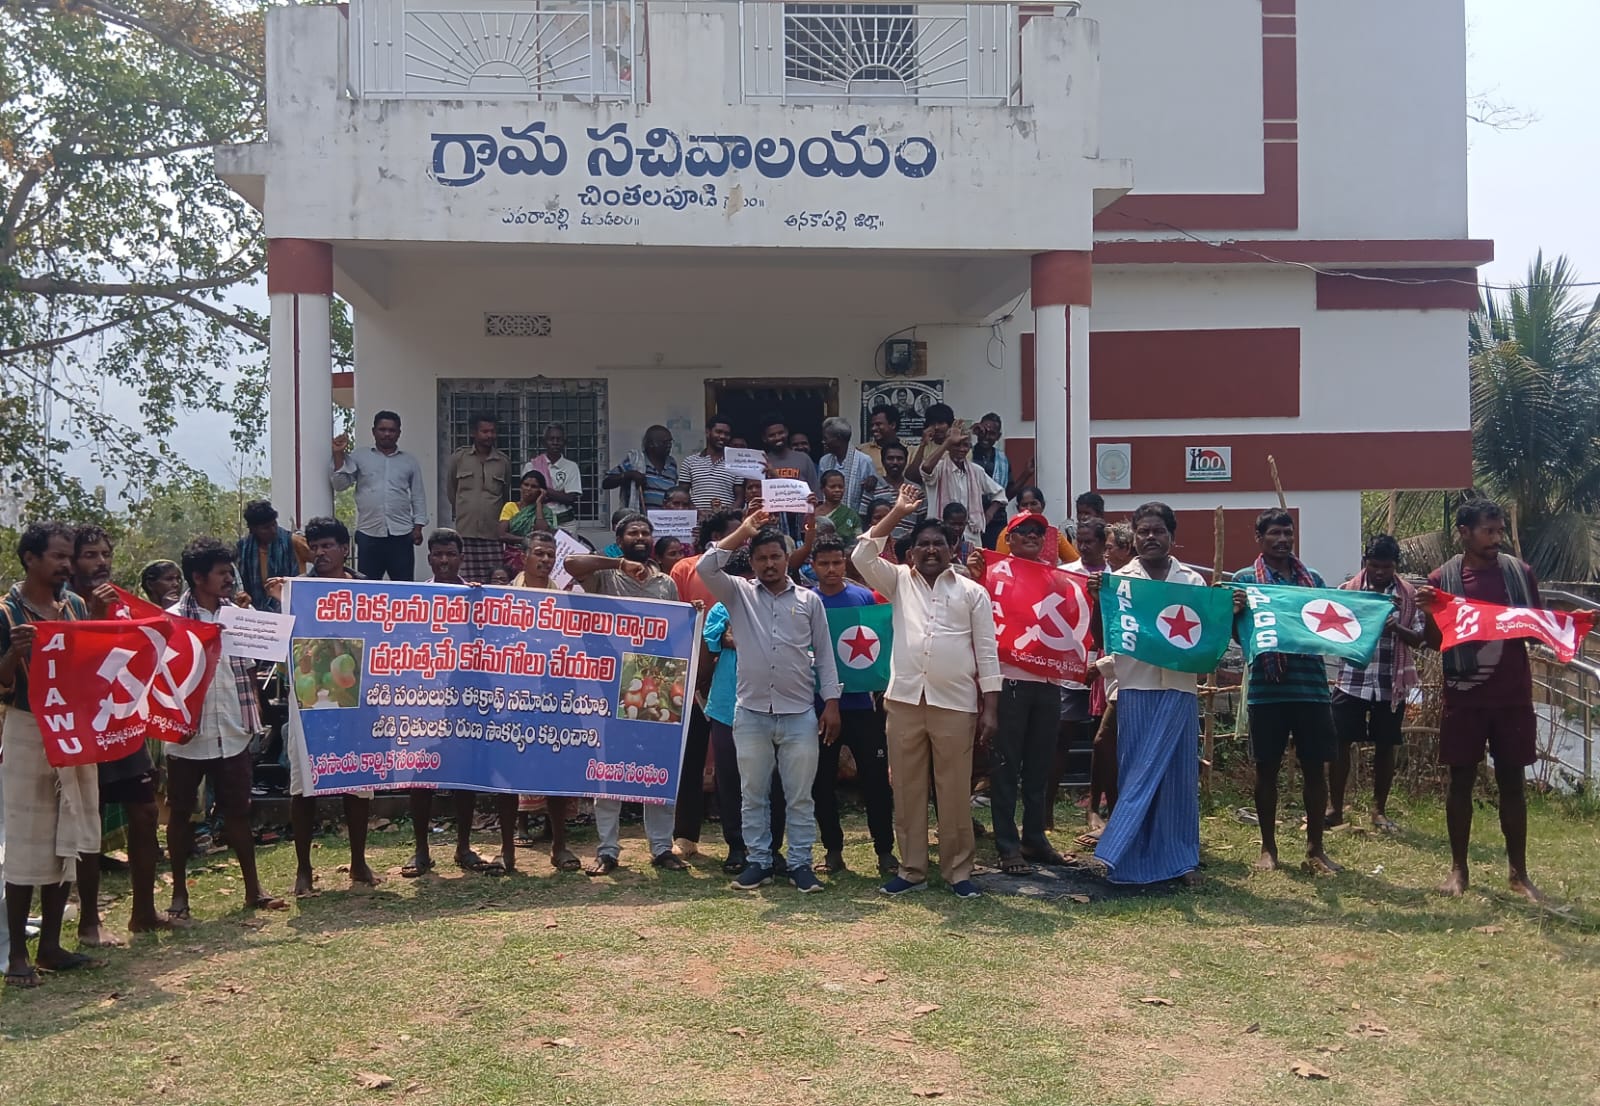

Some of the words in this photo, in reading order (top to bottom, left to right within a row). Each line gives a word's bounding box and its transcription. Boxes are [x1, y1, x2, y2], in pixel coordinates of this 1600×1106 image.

[429, 120, 567, 187] గ్రామ
[587, 122, 938, 180] సచివాలయం
[784, 211, 847, 231] అనకాపల్లి
[317, 591, 352, 621] జీడి
[356, 594, 429, 632] పిక్కలను
[431, 595, 470, 633] రైతు
[537, 596, 613, 637] కేంద్రాలు
[616, 614, 669, 647] ద్వారా
[1116, 579, 1140, 652] APGS
[369, 637, 456, 679] ప్రభుత్వమే
[549, 644, 616, 681] చేయాలి
[41, 632, 83, 755] AIAWU
[366, 684, 392, 706] జీడి
[507, 690, 558, 713] నమోదు
[371, 715, 396, 738] జీడి
[397, 716, 453, 746] రైతులకు
[455, 718, 483, 739] రుణ
[360, 750, 395, 780] కార్మిక
[396, 748, 440, 773] సంఘం
[586, 758, 625, 782] గిరిజన
[625, 762, 669, 788] సంఘం
